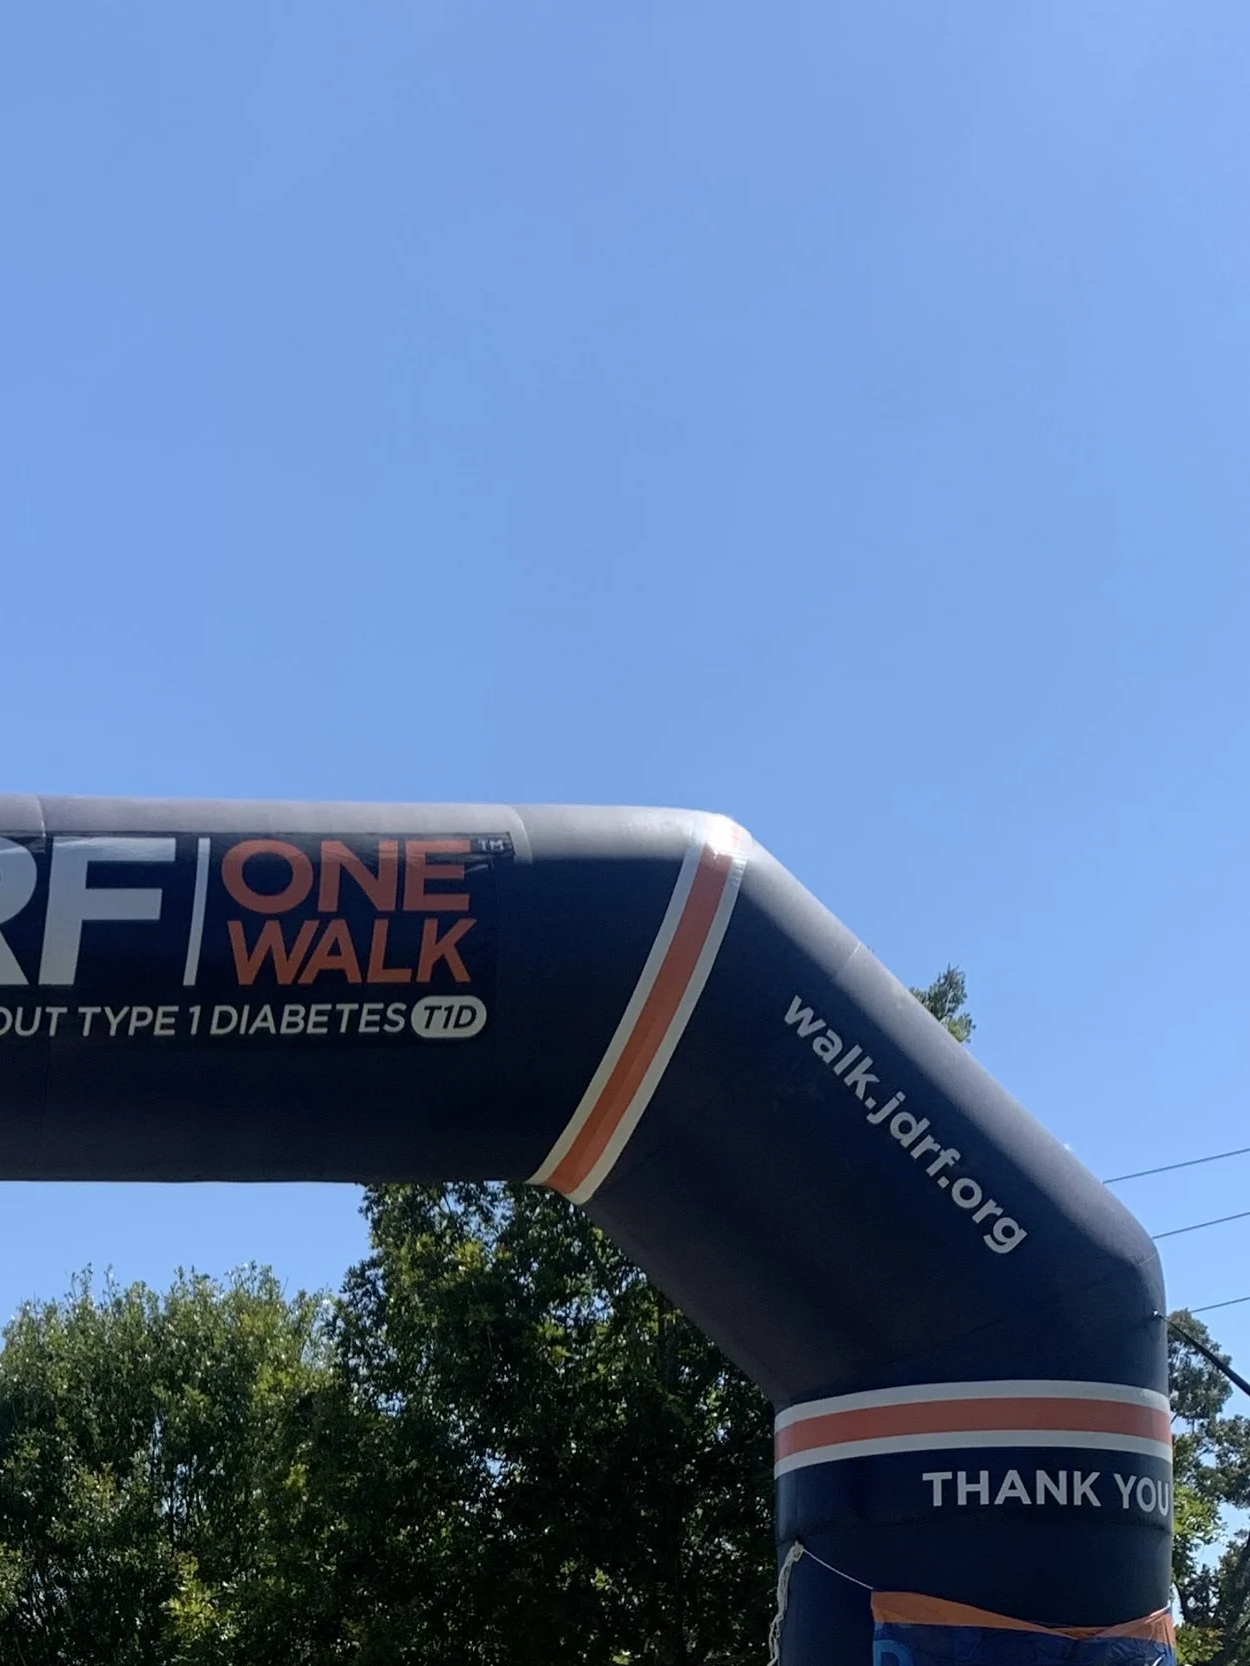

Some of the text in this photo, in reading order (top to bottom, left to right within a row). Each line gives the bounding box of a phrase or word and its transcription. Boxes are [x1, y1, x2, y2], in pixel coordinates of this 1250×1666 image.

[221, 838, 471, 914] ONE
[227, 918, 477, 986] WALK
[78, 1006, 179, 1037] TYPE
[189, 1006, 201, 1036] 1
[210, 1003, 408, 1036] DIABETES
[423, 1004, 478, 1030] T1D
[784, 994, 1028, 1254] walk.jdrf.org
[922, 1469, 1169, 1517] THANK YOU
